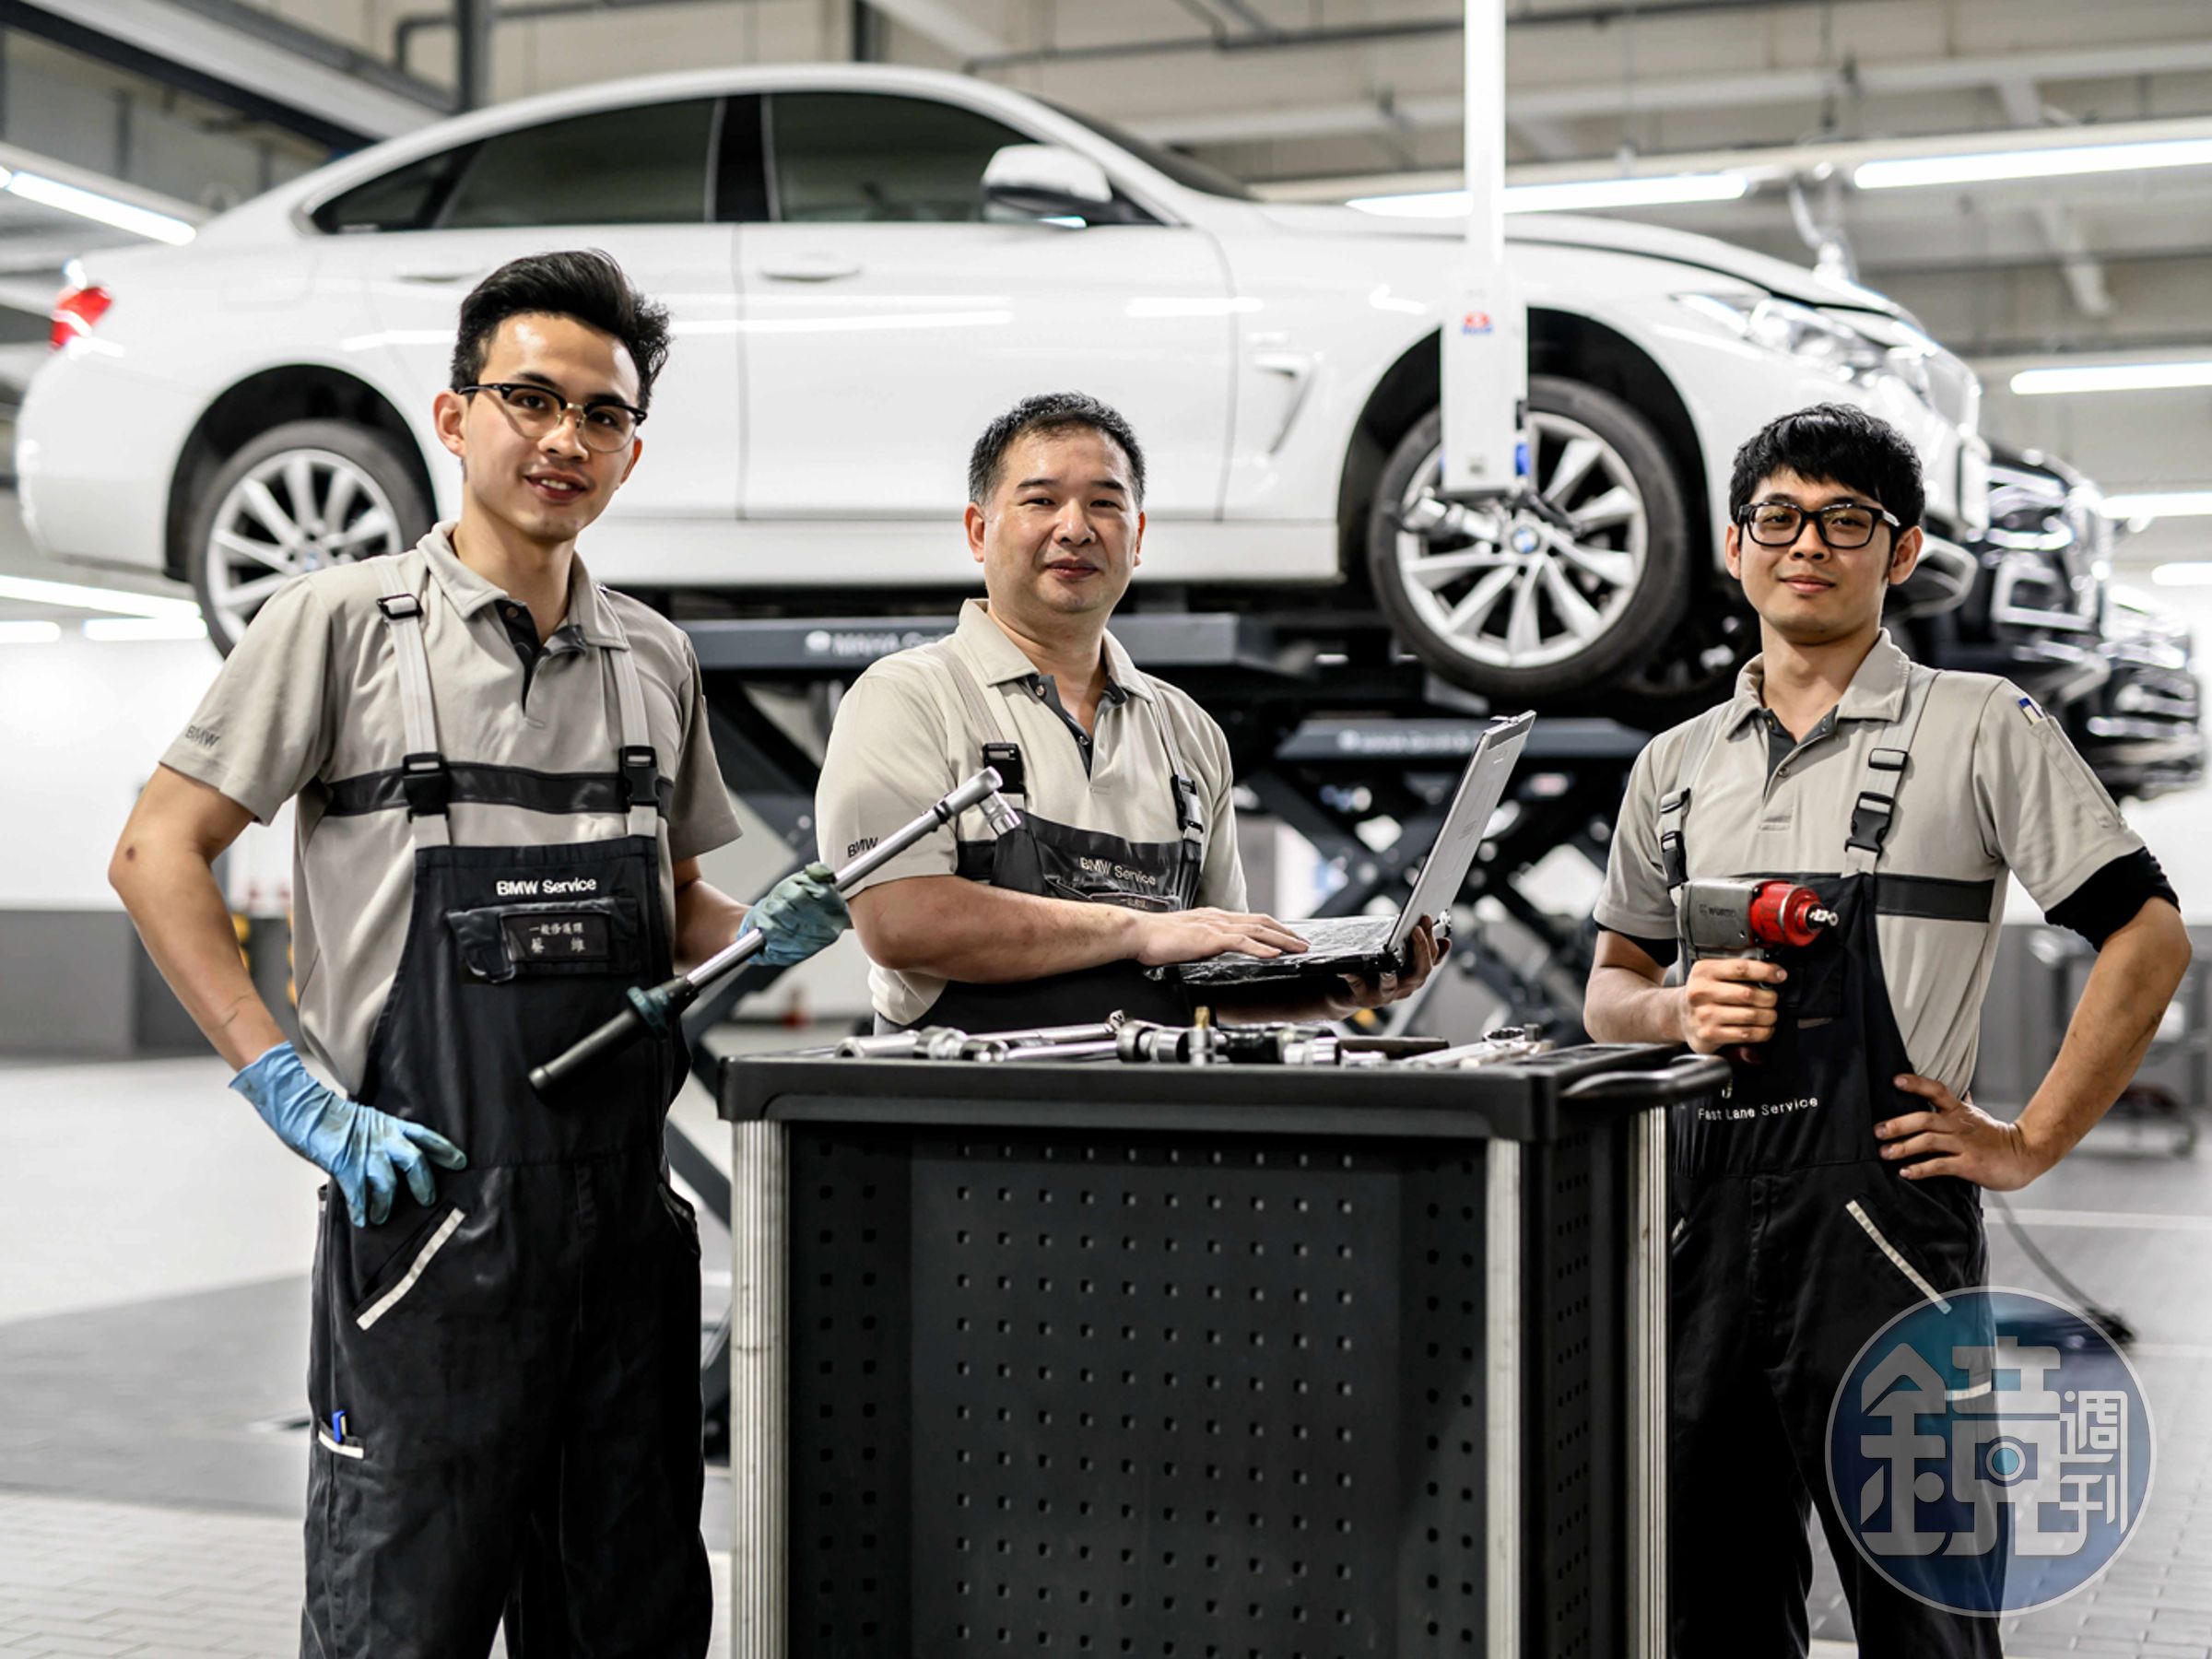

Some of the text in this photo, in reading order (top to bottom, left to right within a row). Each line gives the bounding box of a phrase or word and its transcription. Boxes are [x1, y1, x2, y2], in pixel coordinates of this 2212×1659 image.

[185, 724, 220, 748] BMW
[1079, 856, 1157, 886] BMW Service
[496, 877, 597, 896] BMW Service
[1698, 1098, 1818, 1121] Fast Lane Service
